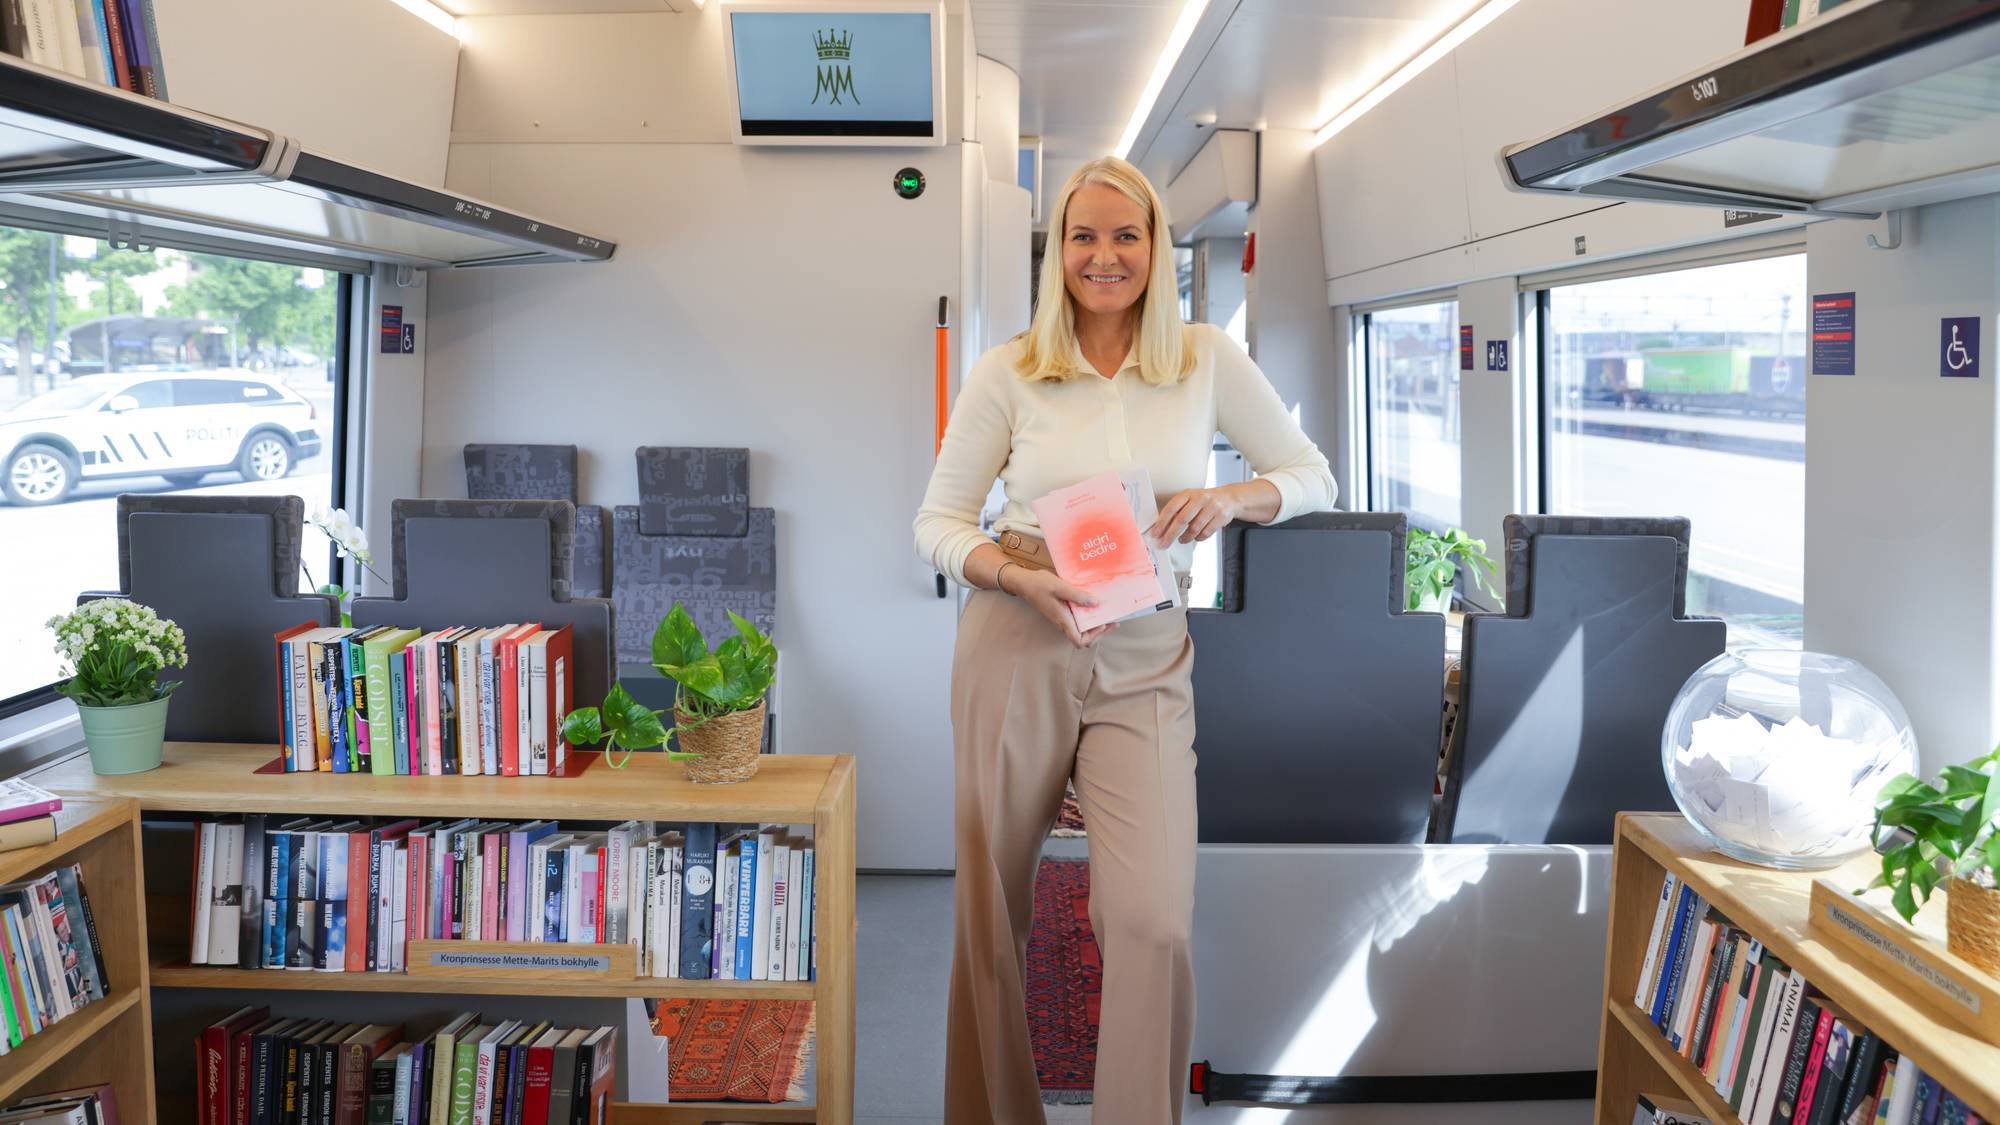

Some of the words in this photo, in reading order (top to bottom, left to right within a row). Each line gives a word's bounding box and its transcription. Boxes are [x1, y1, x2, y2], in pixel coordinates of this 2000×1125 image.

[1697, 77, 1718, 99] 107
[903, 178, 917, 188] WC
[1080, 541, 1118, 561] bedre
[1082, 532, 1110, 551] aldri
[295, 654, 307, 688] FARS
[327, 648, 337, 680] DESPENTES
[328, 686, 338, 710] VERNON
[368, 663, 387, 742] GODSET
[297, 713, 308, 747] RYGG
[330, 711, 340, 736] SUBUTEX
[371, 843, 380, 871] DHARMA
[612, 837, 621, 867] LORRIE
[370, 874, 379, 893] BUMS
[611, 868, 620, 901] MOORE
[738, 858, 753, 936] VINTERBARN
[774, 881, 787, 906] LOLITA
[440, 954, 501, 965] Kronprinsesse
[503, 955, 559, 966] Mette-Marits
[561, 957, 599, 968] bokhylle
[1832, 907, 1883, 946] Kronprinsesse
[1882, 939, 1933, 981] Mette-Marits
[1934, 974, 1974, 1004] bokhylle
[1779, 978, 1800, 1034] ANIMAL
[259, 1042, 268, 1063] NIELS
[258, 1064, 267, 1095] FREDRIK
[302, 1052, 311, 1086] DESPENTES
[324, 1051, 333, 1085] DESPENTES
[454, 1067, 473, 1125] GODS
[479, 1076, 488, 1089] var
[301, 1092, 309, 1116] VERNON
[323, 1091, 331, 1115] VERNON
